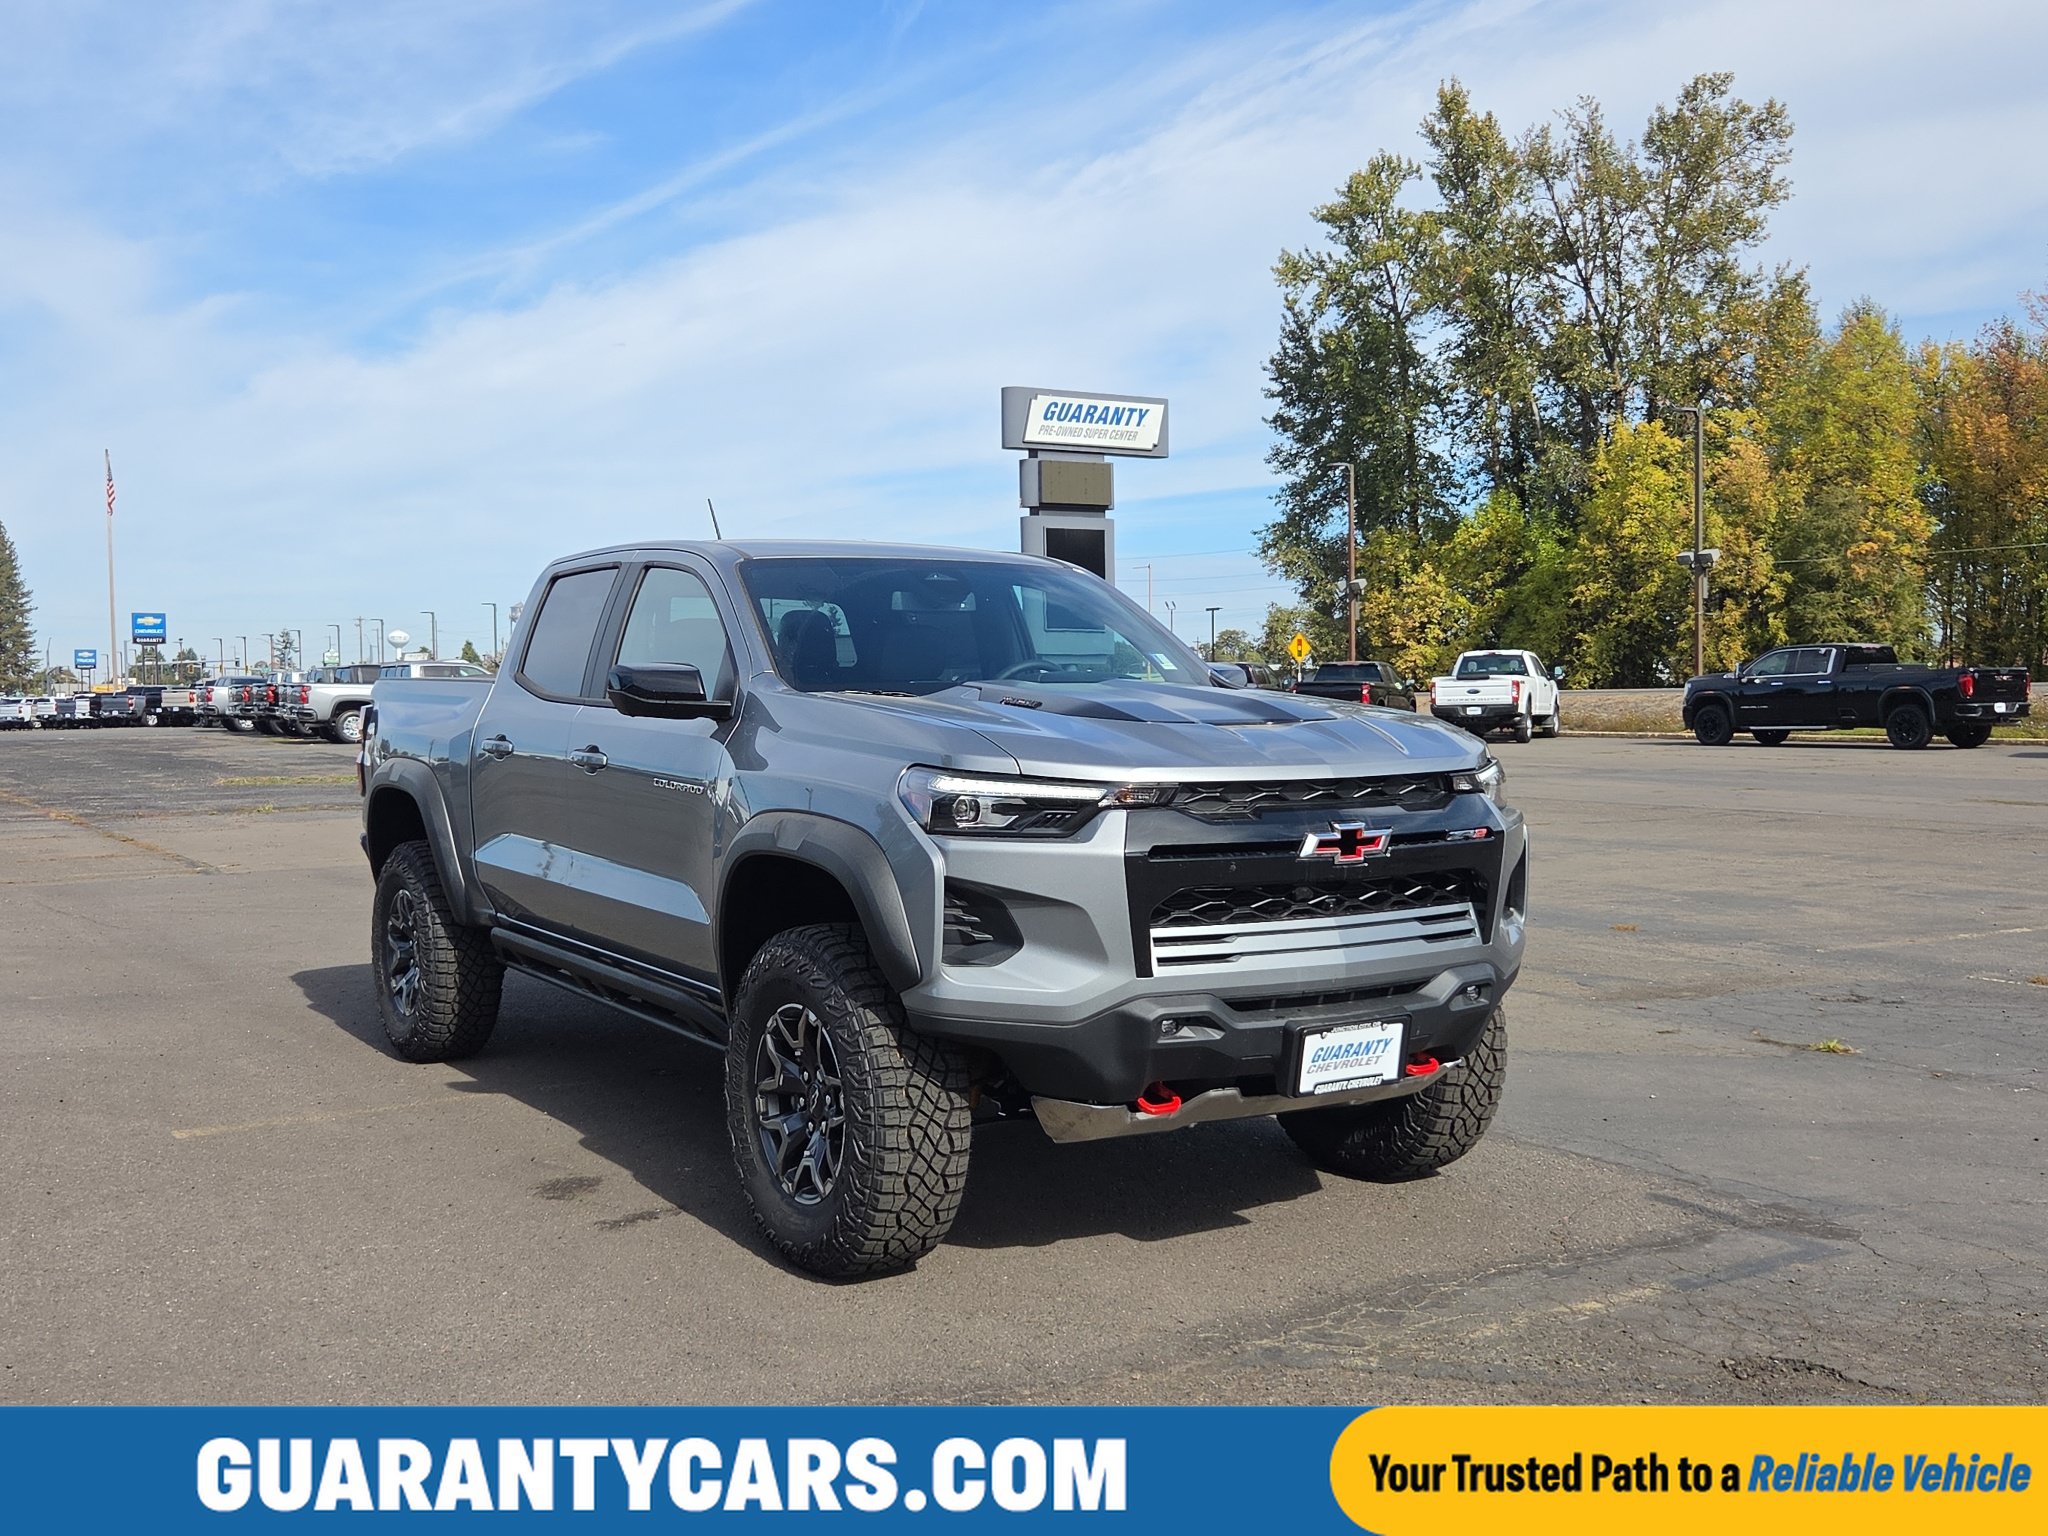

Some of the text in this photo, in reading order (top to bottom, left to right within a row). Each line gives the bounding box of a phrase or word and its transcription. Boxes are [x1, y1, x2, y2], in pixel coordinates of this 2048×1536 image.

[1043, 401, 1150, 428] GUARANTY
[1038, 424, 1138, 442] PRE-OWNED SUPER CENTER
[653, 778, 705, 795] COLORADO
[1311, 1037, 1394, 1064] GUARANTY
[1306, 1055, 1383, 1074] CHEVROLET
[1314, 1075, 1384, 1095] GUARANTY CHEVROLET
